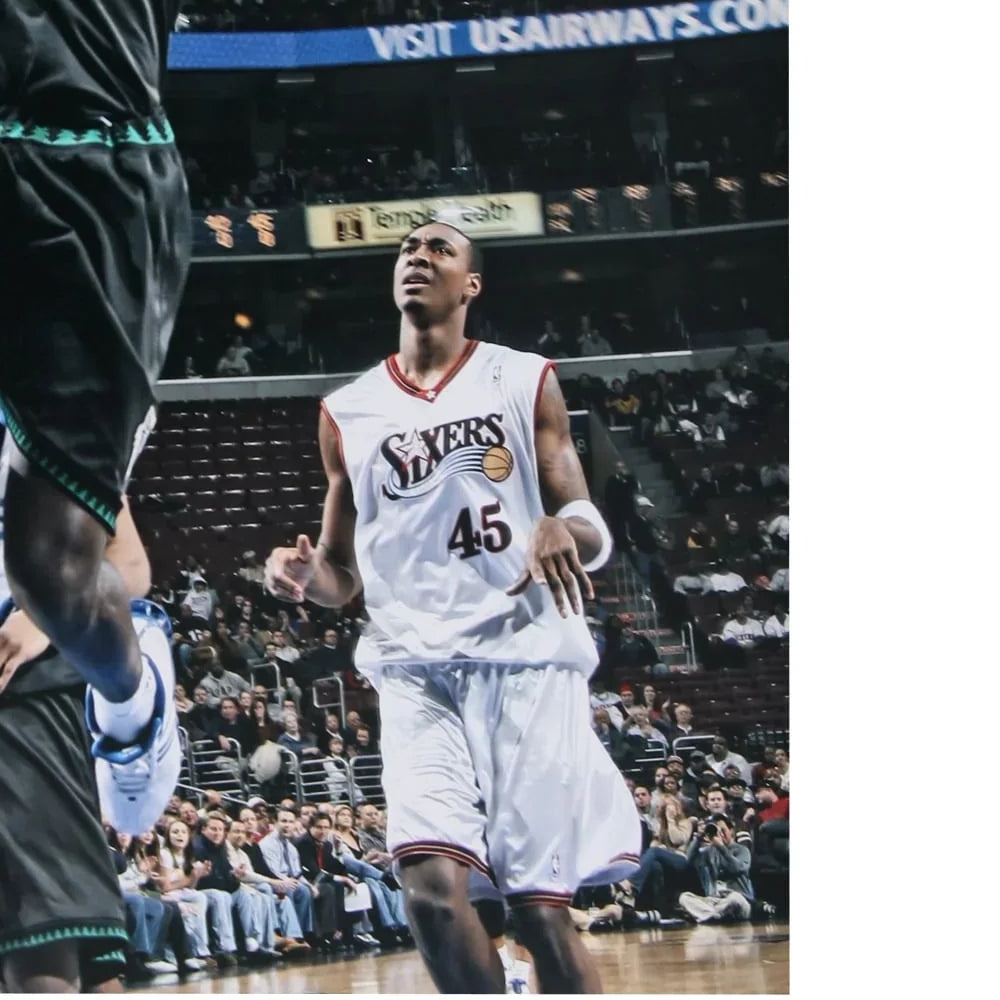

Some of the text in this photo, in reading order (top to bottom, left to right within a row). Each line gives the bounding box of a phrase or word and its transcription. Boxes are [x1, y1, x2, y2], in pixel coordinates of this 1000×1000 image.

[367, 21, 456, 60] VISIT
[381, 413, 506, 500] SIXERS
[447, 500, 512, 560] 45
